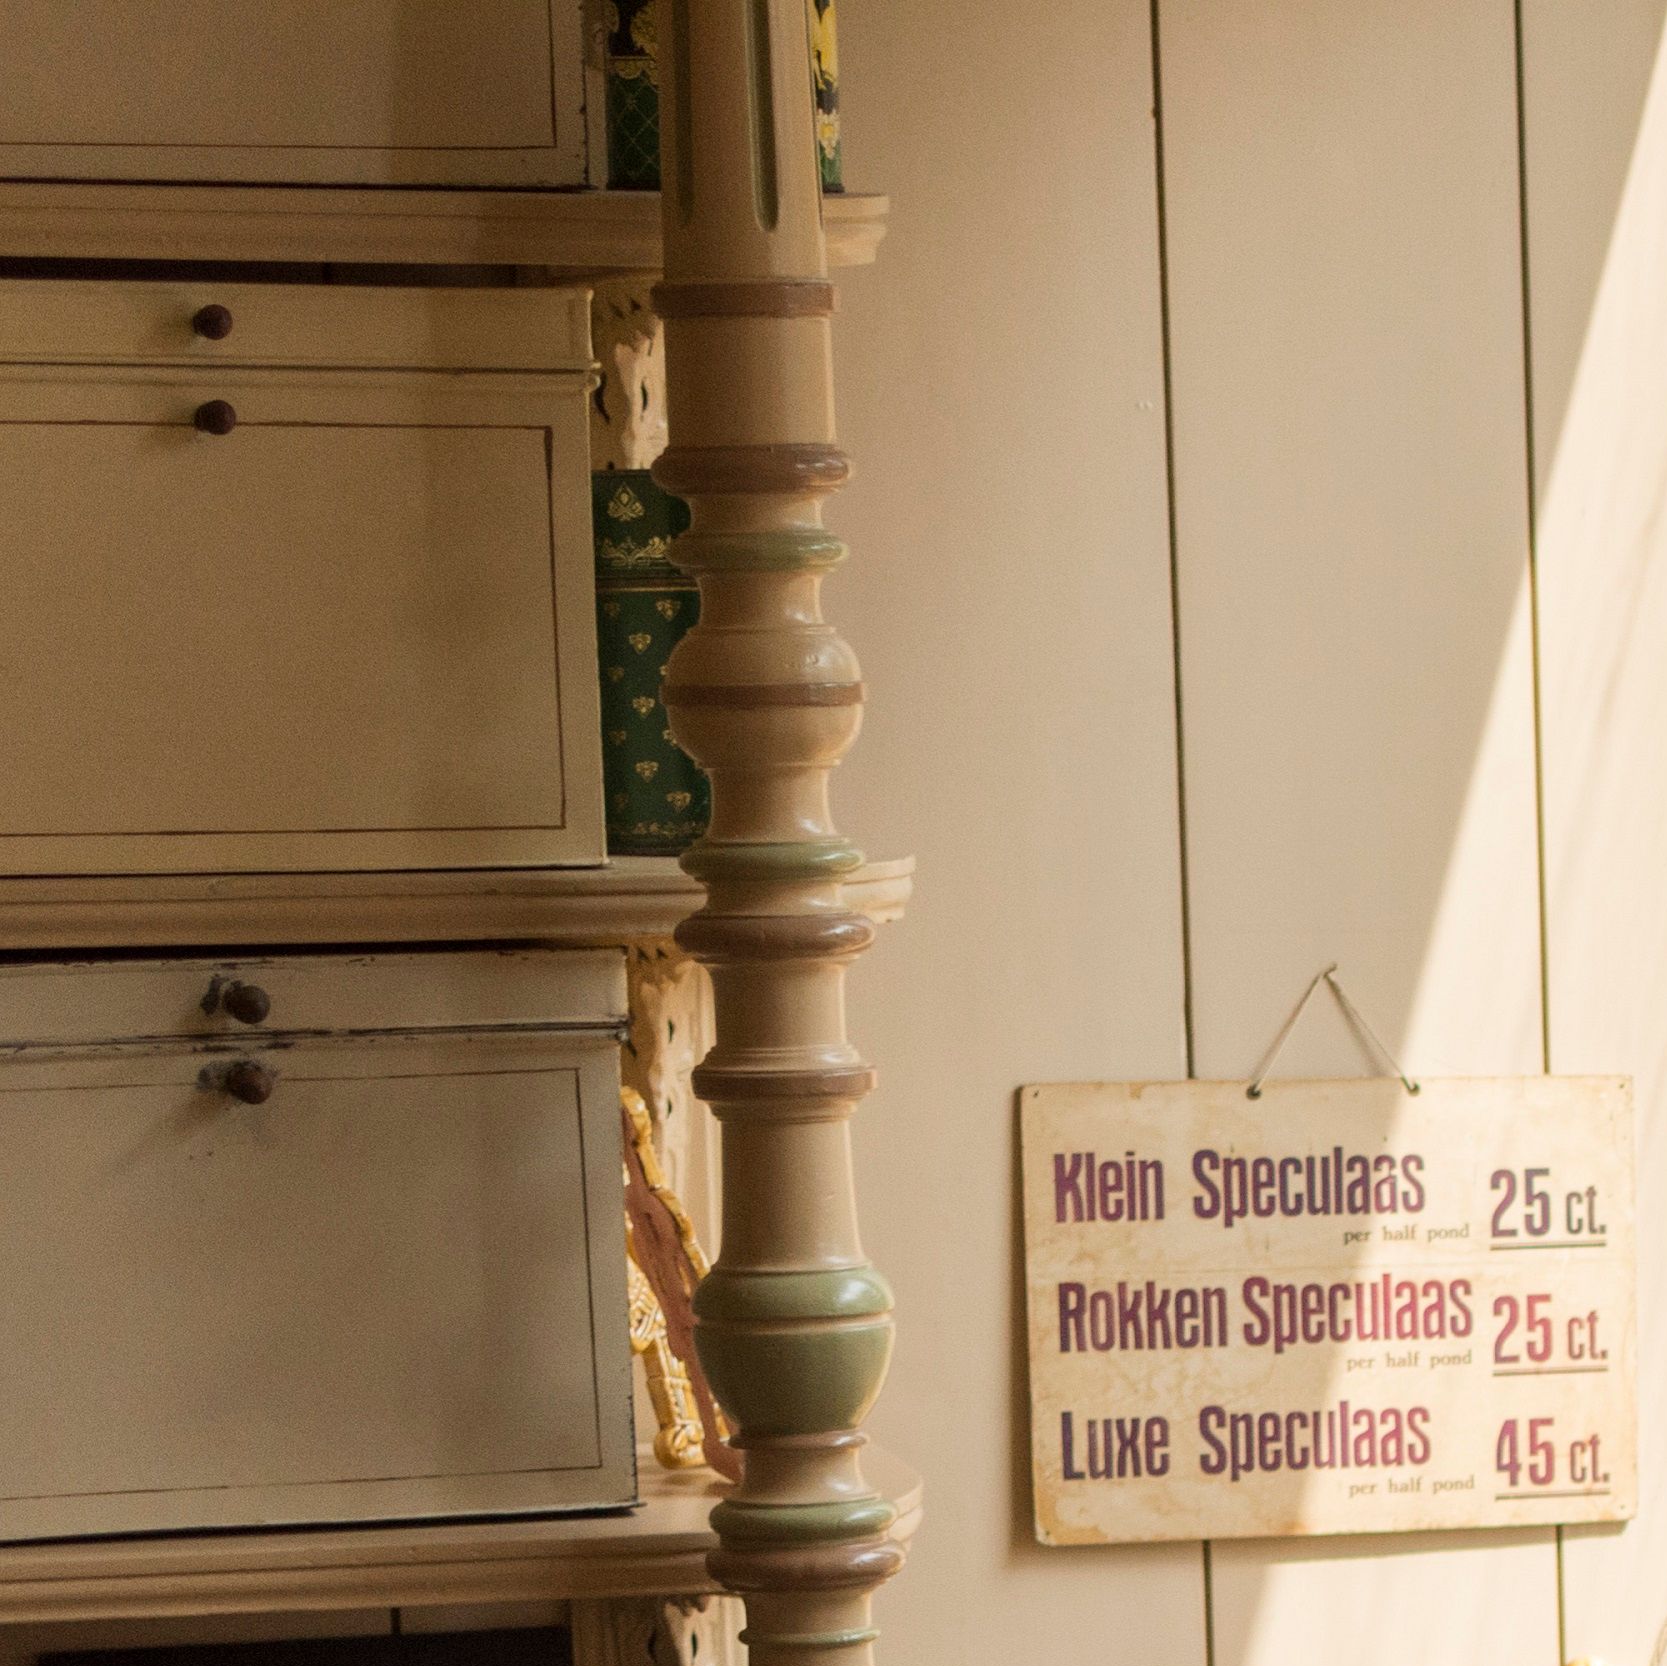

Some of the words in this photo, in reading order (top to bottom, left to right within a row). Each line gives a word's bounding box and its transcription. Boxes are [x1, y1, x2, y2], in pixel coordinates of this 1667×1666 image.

[1053, 1151, 1166, 1223] Klein
[1192, 1146, 1426, 1228] Speculaas
[1490, 1167, 1552, 1239] 25
[1565, 1184, 1607, 1235] ct.
[1343, 1228, 1372, 1246] per
[1382, 1224, 1418, 1242] half
[1426, 1223, 1470, 1242] pond
[1058, 1280, 1229, 1354] Rokken
[1242, 1273, 1473, 1354] Speculaas
[1492, 1293, 1553, 1365] 25
[1567, 1310, 1609, 1360] ct.
[1346, 1356, 1375, 1373] per
[1385, 1352, 1420, 1369] half
[1429, 1350, 1473, 1369] pond
[1060, 1410, 1171, 1482] Luxe
[1199, 1400, 1432, 1482] Speculaas
[1496, 1417, 1556, 1488] 45
[1570, 1433, 1611, 1483] ct.
[1348, 1481, 1378, 1498] per
[1387, 1476, 1423, 1494] half
[1432, 1475, 1476, 1494] pond
